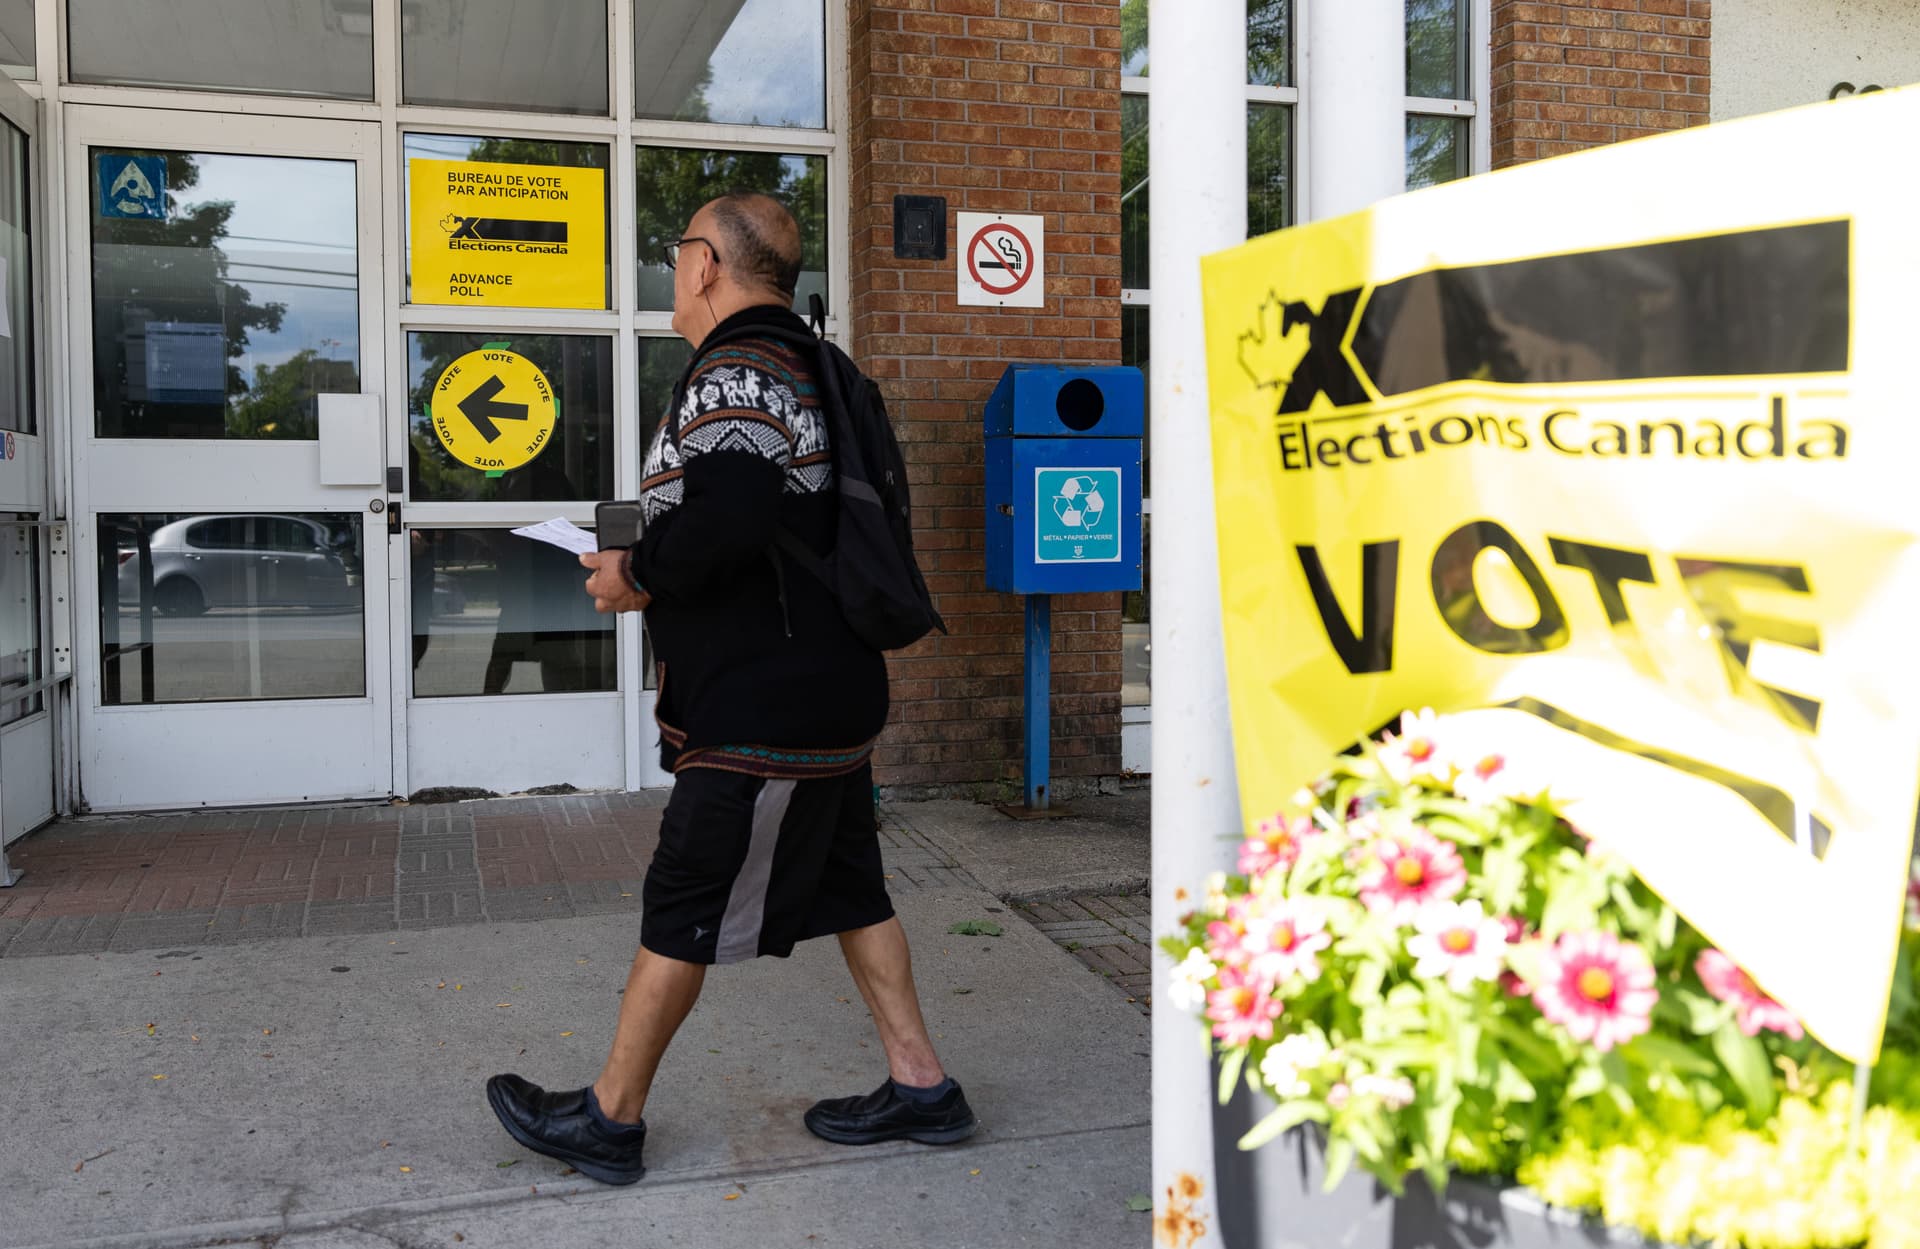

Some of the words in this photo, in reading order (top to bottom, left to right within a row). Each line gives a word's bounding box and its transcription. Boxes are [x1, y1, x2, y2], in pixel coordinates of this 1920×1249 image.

[448, 172, 502, 185] BUREAU
[506, 175, 524, 186] DE
[527, 176, 561, 188] VOTE
[448, 185, 475, 196] PAR
[478, 187, 569, 201] ANTICIPATION
[449, 240, 513, 253] Elections
[516, 243, 568, 255] Canada
[449, 273, 513, 285] ADVANCE
[450, 286, 484, 297] POLL
[483, 353, 514, 364] VOTE
[439, 365, 462, 392] VOTE
[533, 374, 551, 403] VOTE
[436, 416, 455, 446] VOTE
[1277, 414, 1529, 471] Elections
[1543, 396, 1848, 459] Canada
[526, 428, 548, 454] VOTE
[474, 456, 505, 467] VOTE
[1294, 519, 1824, 735] VOTE
